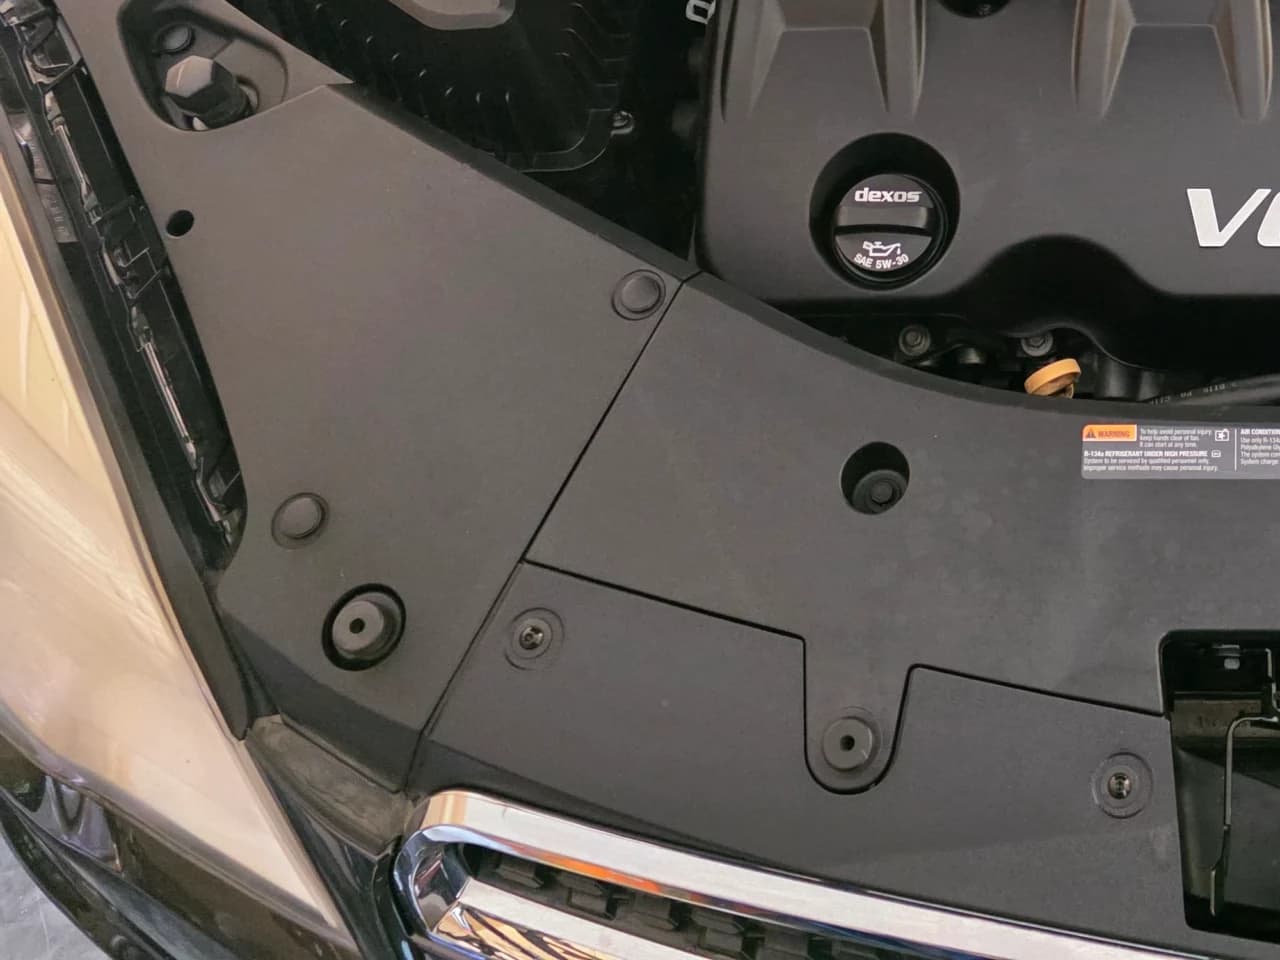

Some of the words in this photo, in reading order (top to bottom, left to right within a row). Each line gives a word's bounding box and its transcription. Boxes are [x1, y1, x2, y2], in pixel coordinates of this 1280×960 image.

[854, 187, 922, 202] dexos
[854, 253, 873, 268] SAE
[875, 253, 910, 270] 5W-30
[1098, 430, 1130, 439] WARNING
